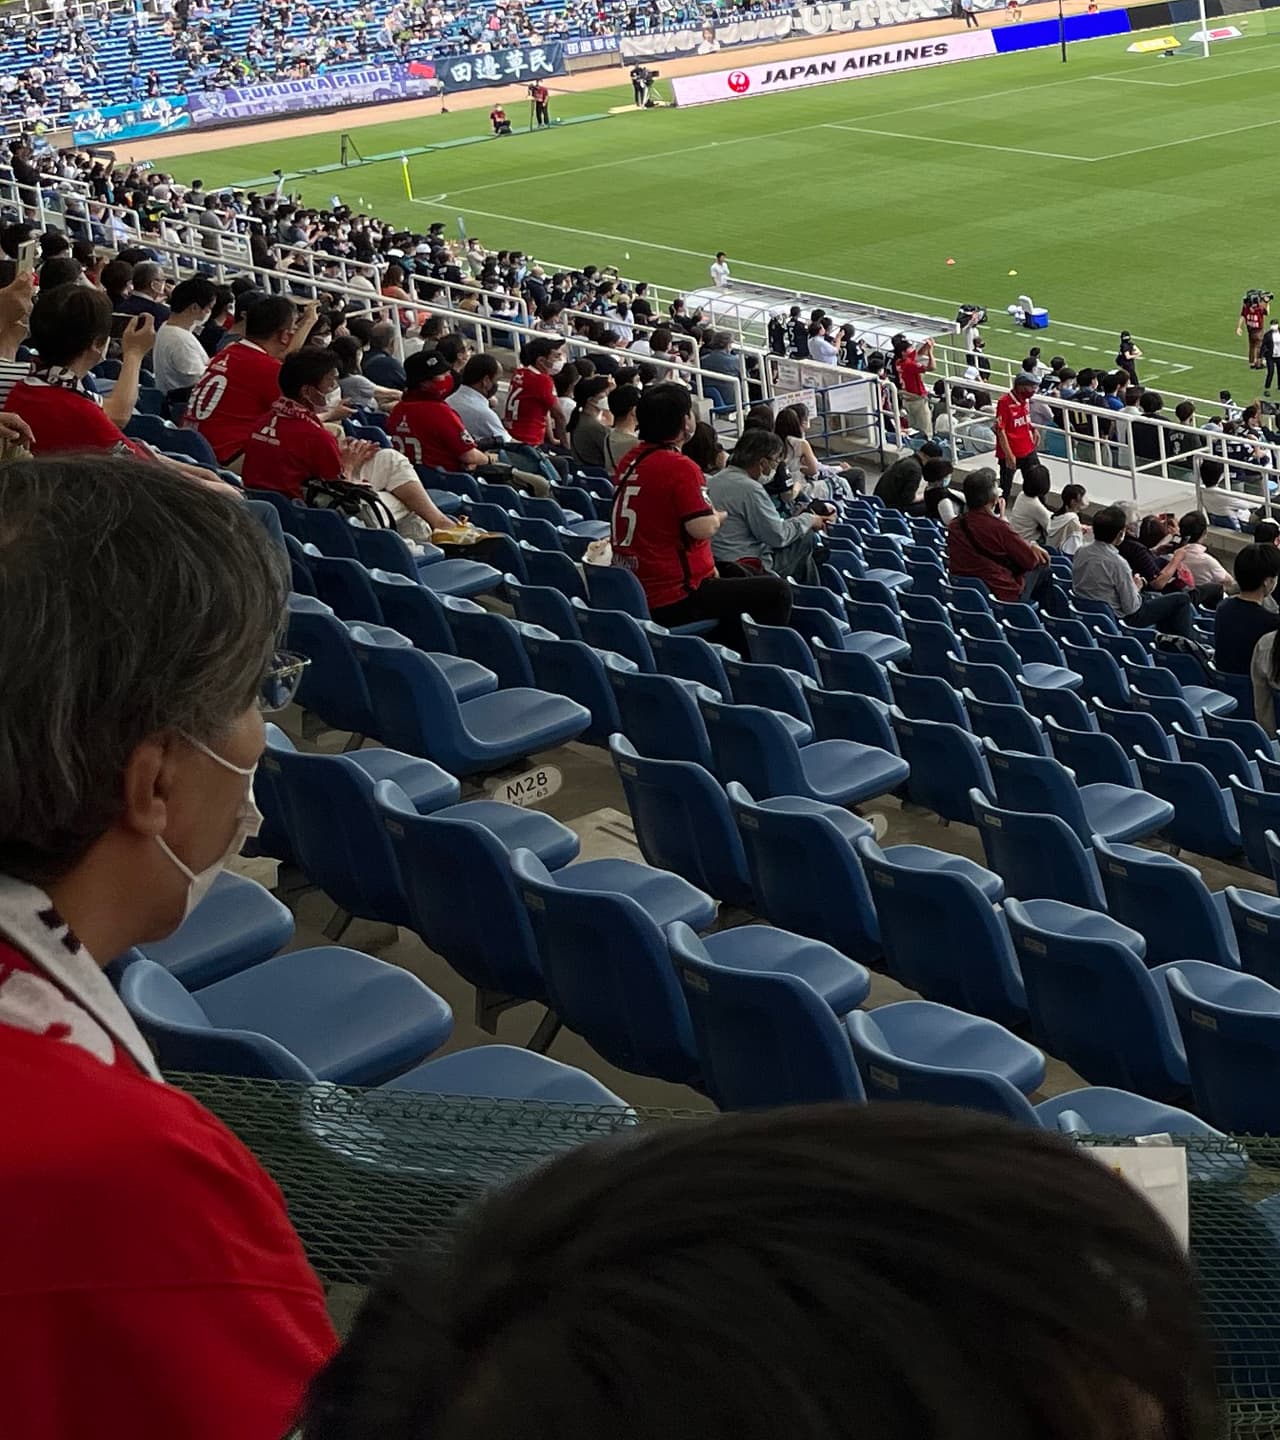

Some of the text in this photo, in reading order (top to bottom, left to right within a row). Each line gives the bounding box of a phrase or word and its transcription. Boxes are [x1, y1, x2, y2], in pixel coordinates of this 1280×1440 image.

[761, 42, 949, 86] JAPAN AIRLINES
[238, 68, 389, 102] FUKUOKA PRIDE
[612, 486, 641, 547] 15
[506, 772, 548, 799] M28
